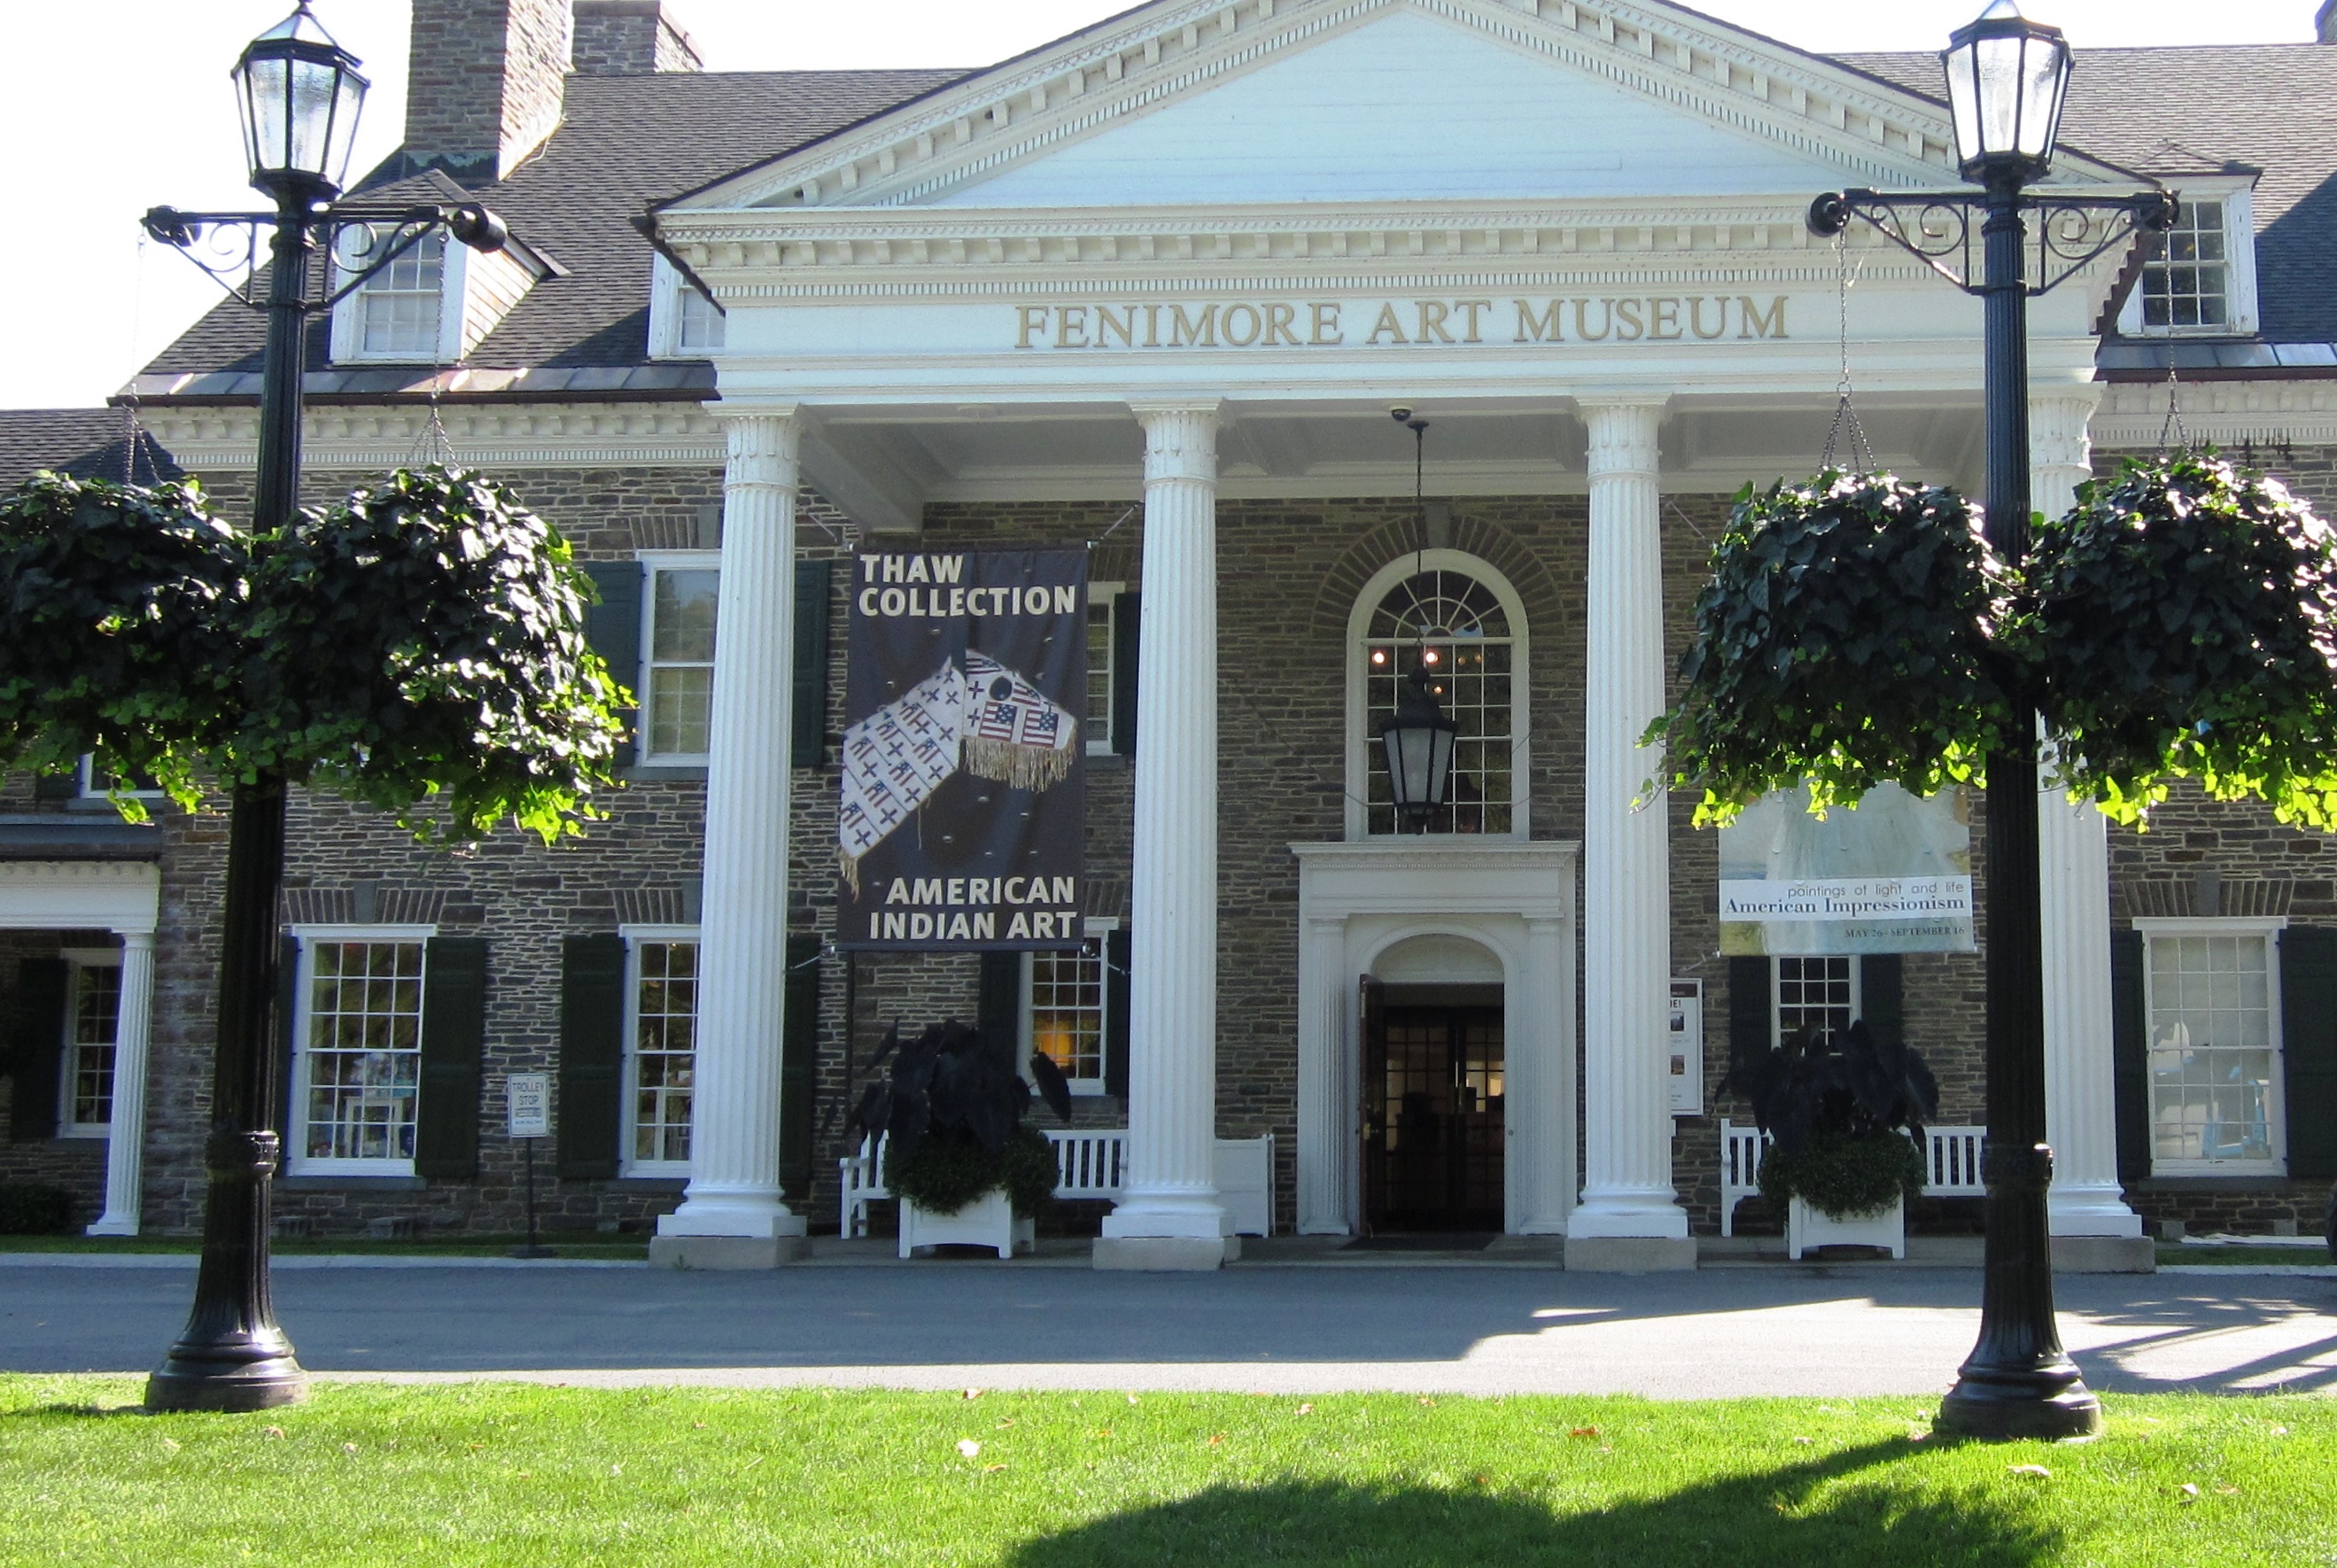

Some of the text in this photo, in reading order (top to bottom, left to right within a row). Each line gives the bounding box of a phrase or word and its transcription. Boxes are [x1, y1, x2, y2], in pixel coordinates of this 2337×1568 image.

[1014, 295, 1790, 348] FENIMORE ART MUSEUM
[859, 555, 963, 583] THAW
[858, 586, 1076, 617] COLLECTION
[885, 876, 1075, 904] AMERICAN
[1788, 881, 1964, 899] paintings of light and life
[1725, 895, 1964, 917] American Impressionism
[870, 911, 1077, 940] INDIAN ART
[1845, 929, 1868, 938] MAY
[1891, 927, 1950, 937] SEPTEMBER
[1954, 927, 1964, 935] 16
[512, 1083, 544, 1092] TROLLEY
[518, 1095, 539, 1106] STOP
